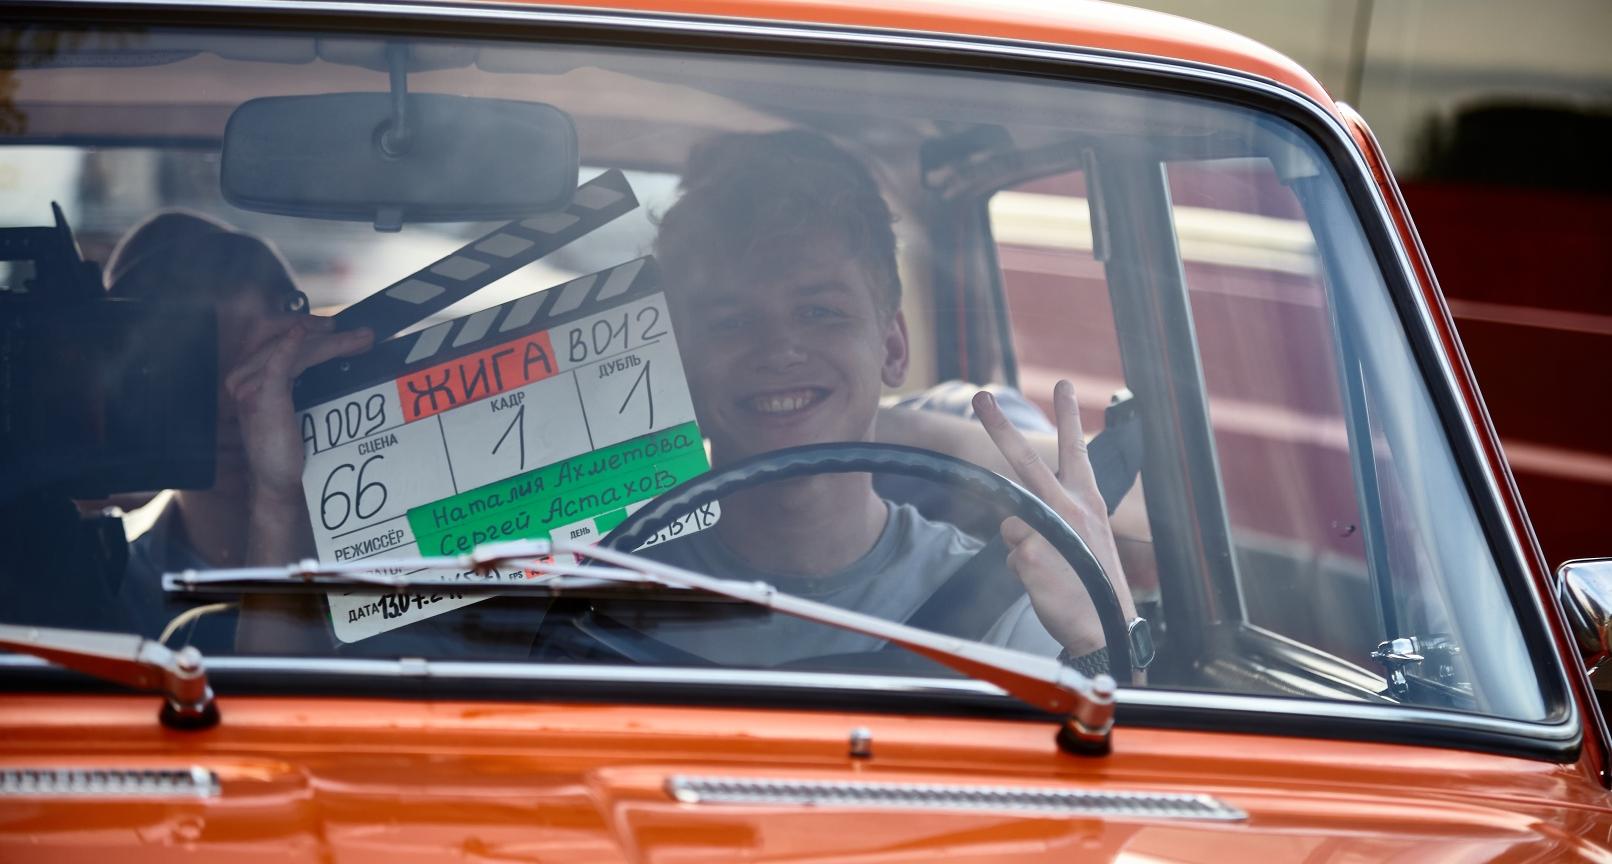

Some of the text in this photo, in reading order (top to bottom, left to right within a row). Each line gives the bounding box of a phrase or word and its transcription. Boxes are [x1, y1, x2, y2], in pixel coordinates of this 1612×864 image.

[407, 342, 553, 417] ЖИГА
[598, 354, 642, 379] ДУБЛЬ
[490, 391, 526, 413] КАДР
[619, 360, 654, 430] 1
[358, 433, 399, 456] СЦЕНА
[491, 404, 525, 470] 1
[320, 454, 388, 531] 66
[432, 432, 694, 529] Наталия Ахметова
[335, 529, 405, 562] РЕЖИССЁР
[440, 511, 530, 556] Сергей
[570, 526, 591, 540] ДЕНЬ
[349, 604, 380, 623] ДАТА
